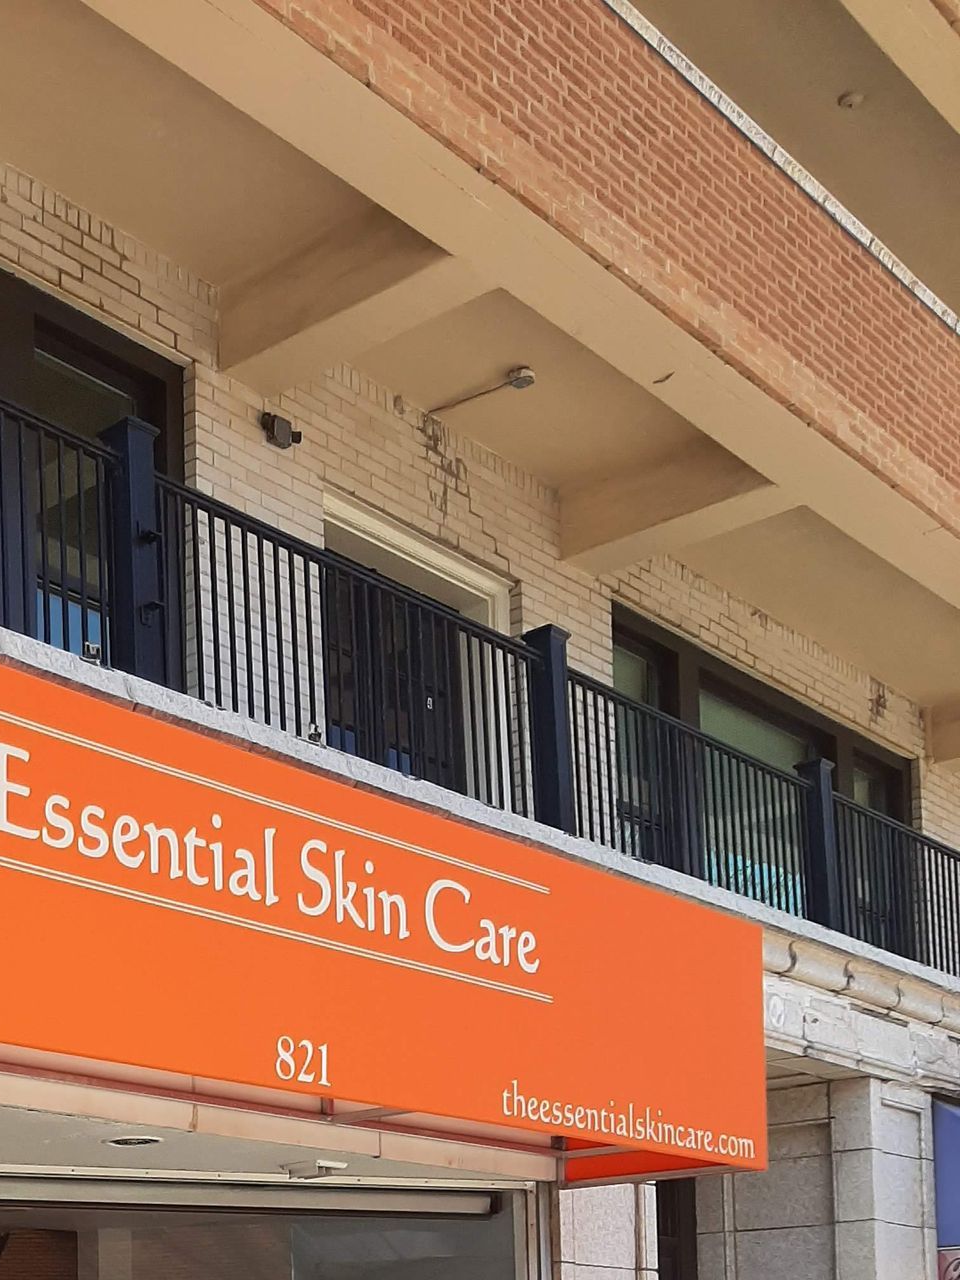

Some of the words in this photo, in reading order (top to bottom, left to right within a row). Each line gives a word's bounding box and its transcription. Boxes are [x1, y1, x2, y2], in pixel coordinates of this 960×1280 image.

[297, 838, 410, 940] Skin
[424, 879, 541, 975] Care
[275, 1035, 332, 1087] 821
[502, 1079, 756, 1160] theessentialskincare.com
